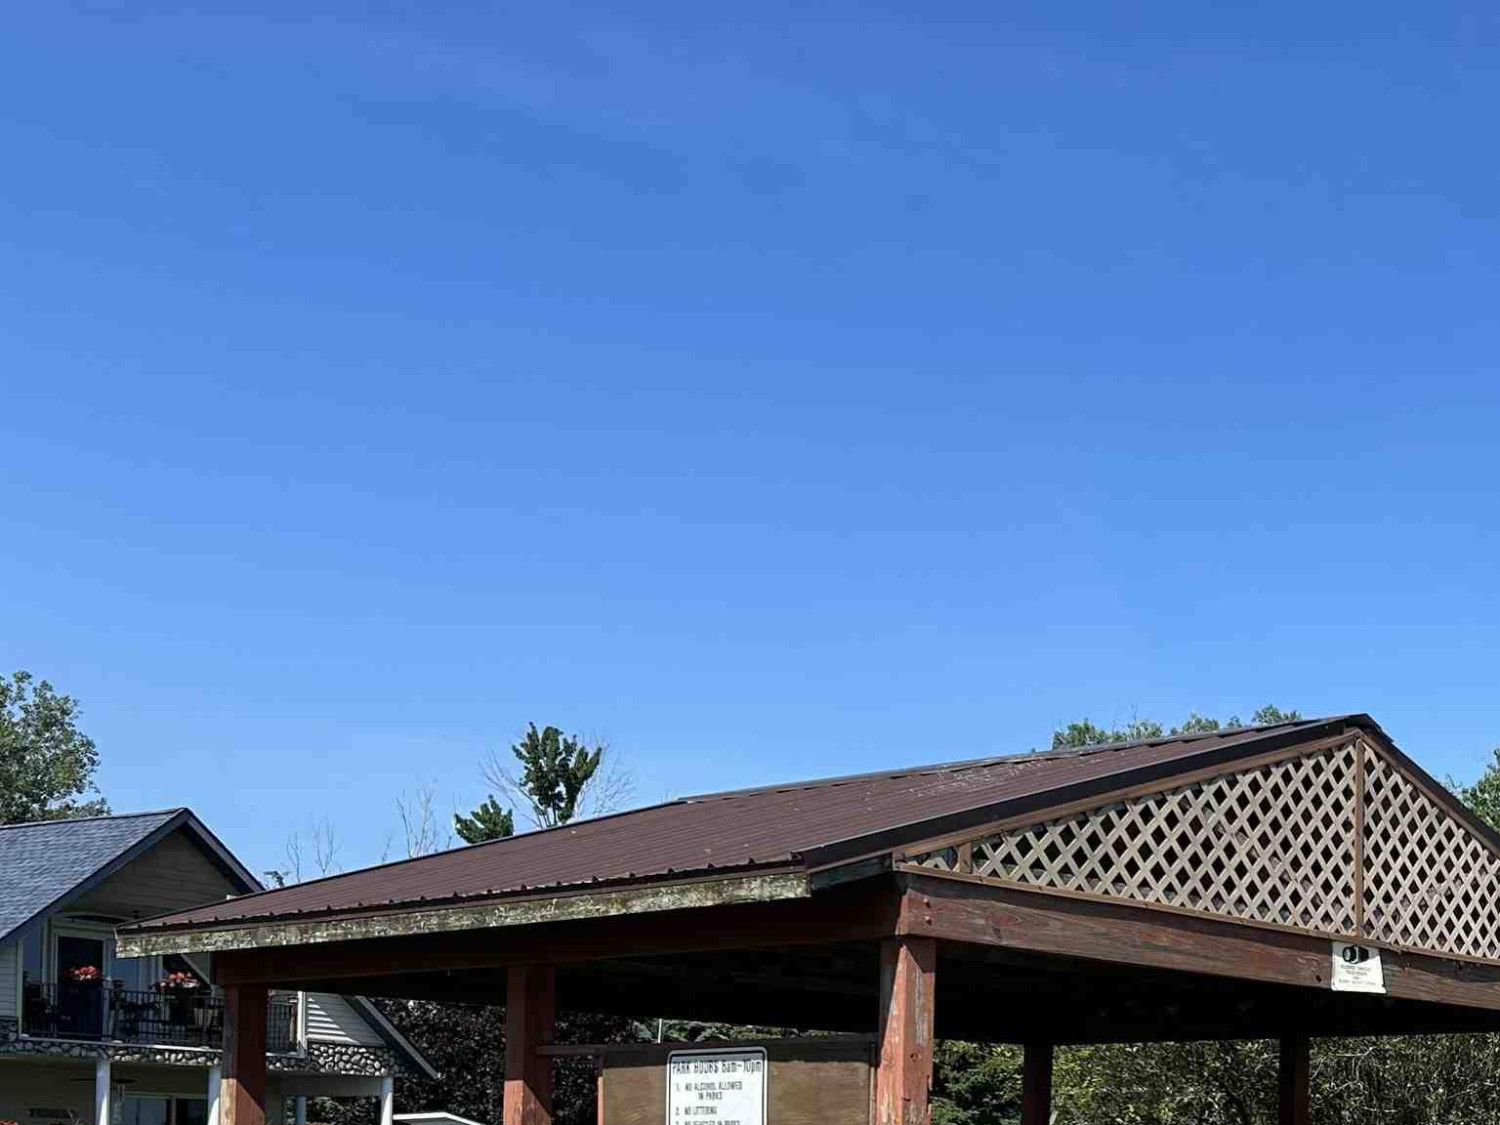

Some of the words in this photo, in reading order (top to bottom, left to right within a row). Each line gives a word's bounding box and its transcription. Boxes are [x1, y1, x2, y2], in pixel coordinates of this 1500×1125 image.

[672, 1061, 690, 1074] PARK
[685, 1083, 693, 1091] NO
[719, 1081, 742, 1090] ALLOWED
[685, 1107, 693, 1115] NO
